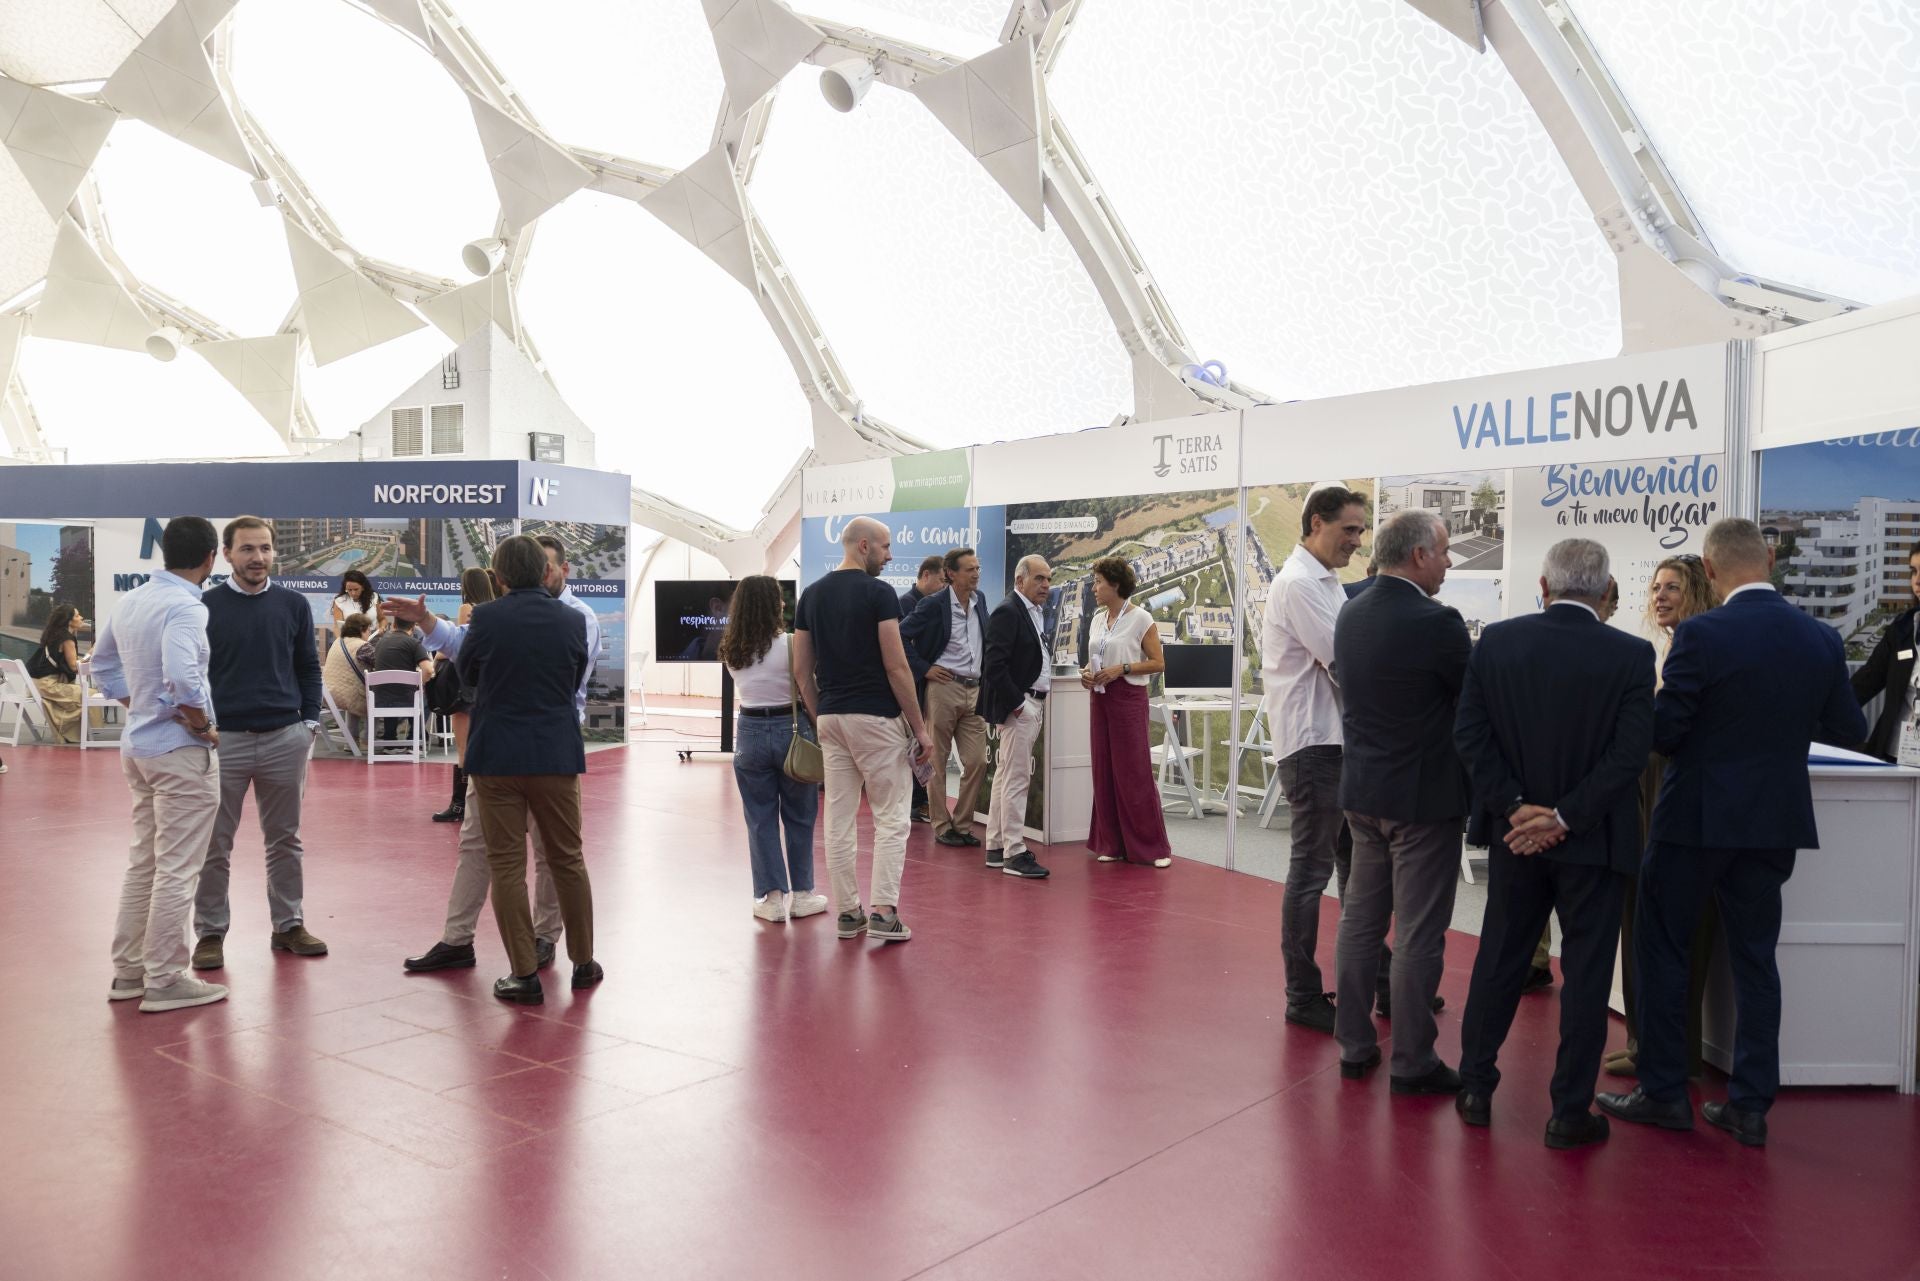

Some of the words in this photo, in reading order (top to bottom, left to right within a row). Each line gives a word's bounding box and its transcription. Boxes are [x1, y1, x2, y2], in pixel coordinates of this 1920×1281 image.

[1452, 377, 1698, 450] VALLENOVA
[1176, 434, 1223, 455] TERRA
[1179, 454, 1218, 474] SATIS
[898, 474, 964, 489] www.mirapinos.com
[1540, 455, 1718, 507] Bienvenido
[374, 484, 507, 505] NORFOREST
[806, 484, 885, 505] MIRAPINOS
[1013, 522, 1034, 531] CAMINO
[1036, 522, 1053, 530] VIEJO
[1054, 521, 1062, 530] DE
[1063, 519, 1095, 529] SIMANCAS
[1556, 509, 1569, 526] a
[1568, 500, 1587, 527] tu
[1593, 504, 1639, 525] nuevo
[1643, 495, 1716, 549] hogar
[896, 524, 914, 545] de
[282, 580, 329, 589] VIVIENDAS
[377, 582, 403, 590] ZONA
[404, 582, 462, 591] FACULTADES
[568, 584, 618, 593] RMITORIOS
[680, 614, 718, 629] respira
